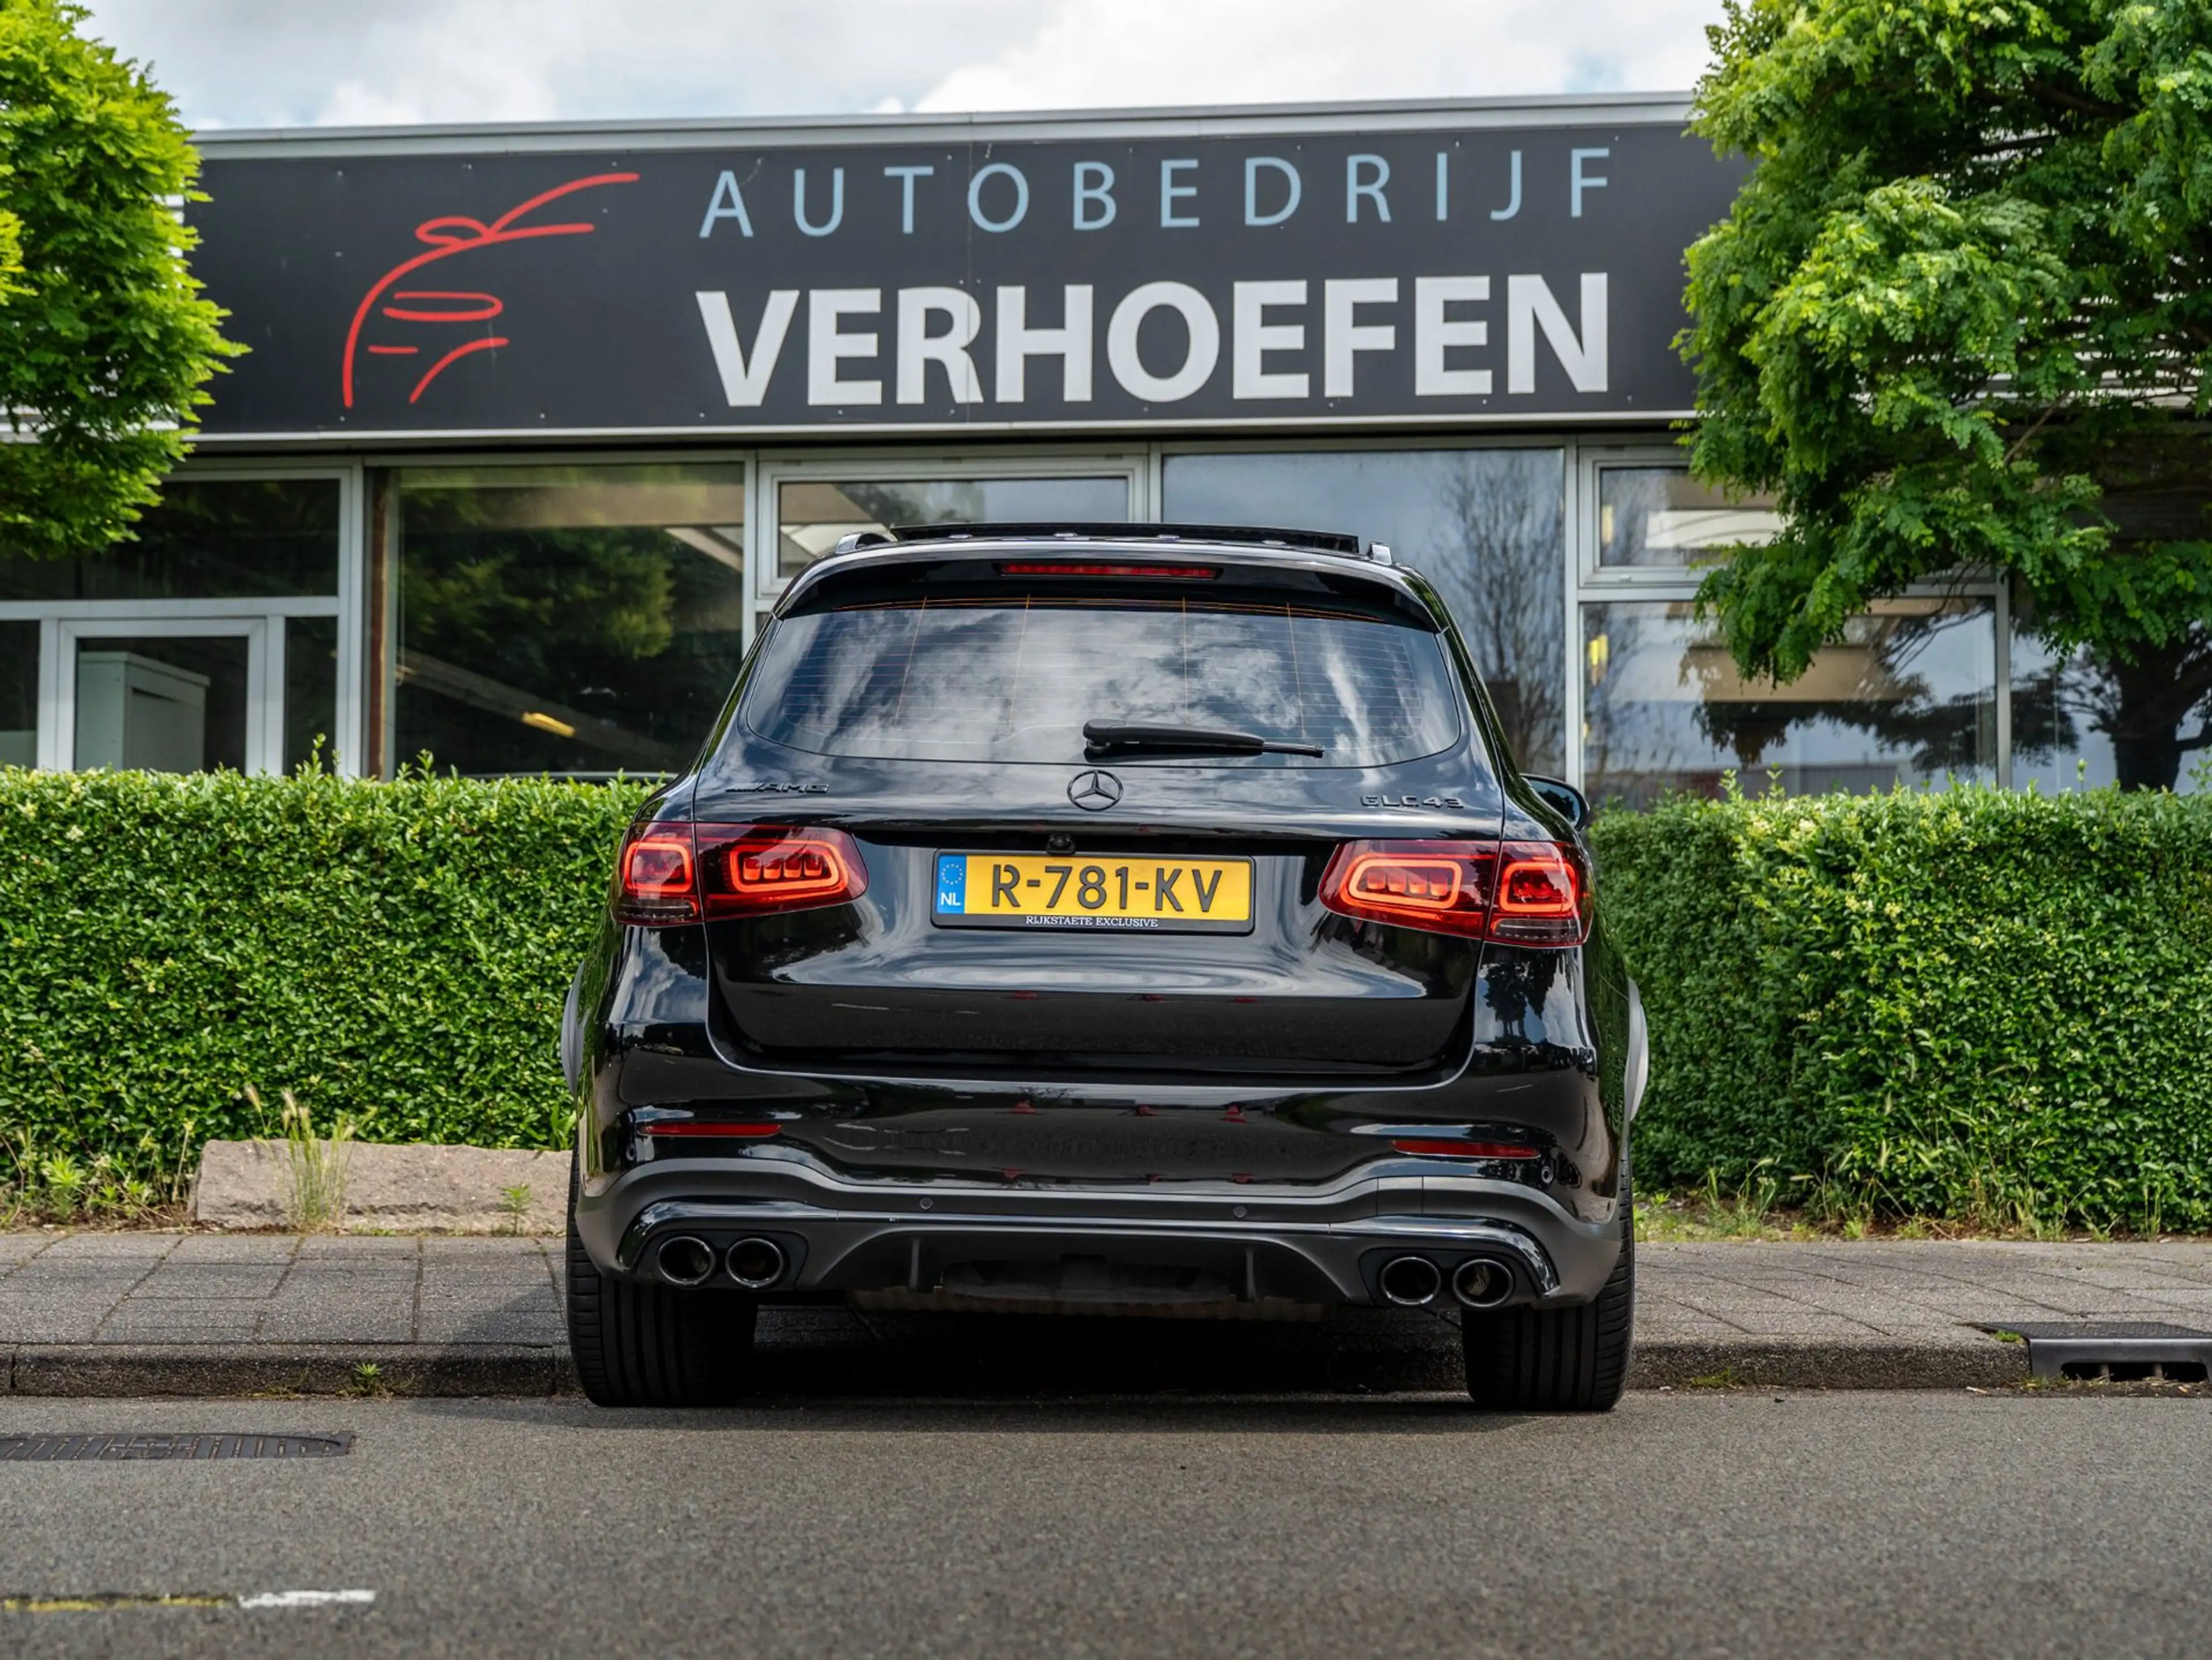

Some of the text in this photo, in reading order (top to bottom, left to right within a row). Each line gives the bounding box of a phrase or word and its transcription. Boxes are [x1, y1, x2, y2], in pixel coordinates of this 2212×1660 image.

[699, 148, 1610, 238] AUTOBEDRIJF
[696, 272, 1608, 407] VERHOEFEN
[941, 892, 961, 906] NL
[991, 864, 1223, 913] R-781-KV
[1025, 915, 1159, 928] RIJKSTAETE EXCLUSIVE
